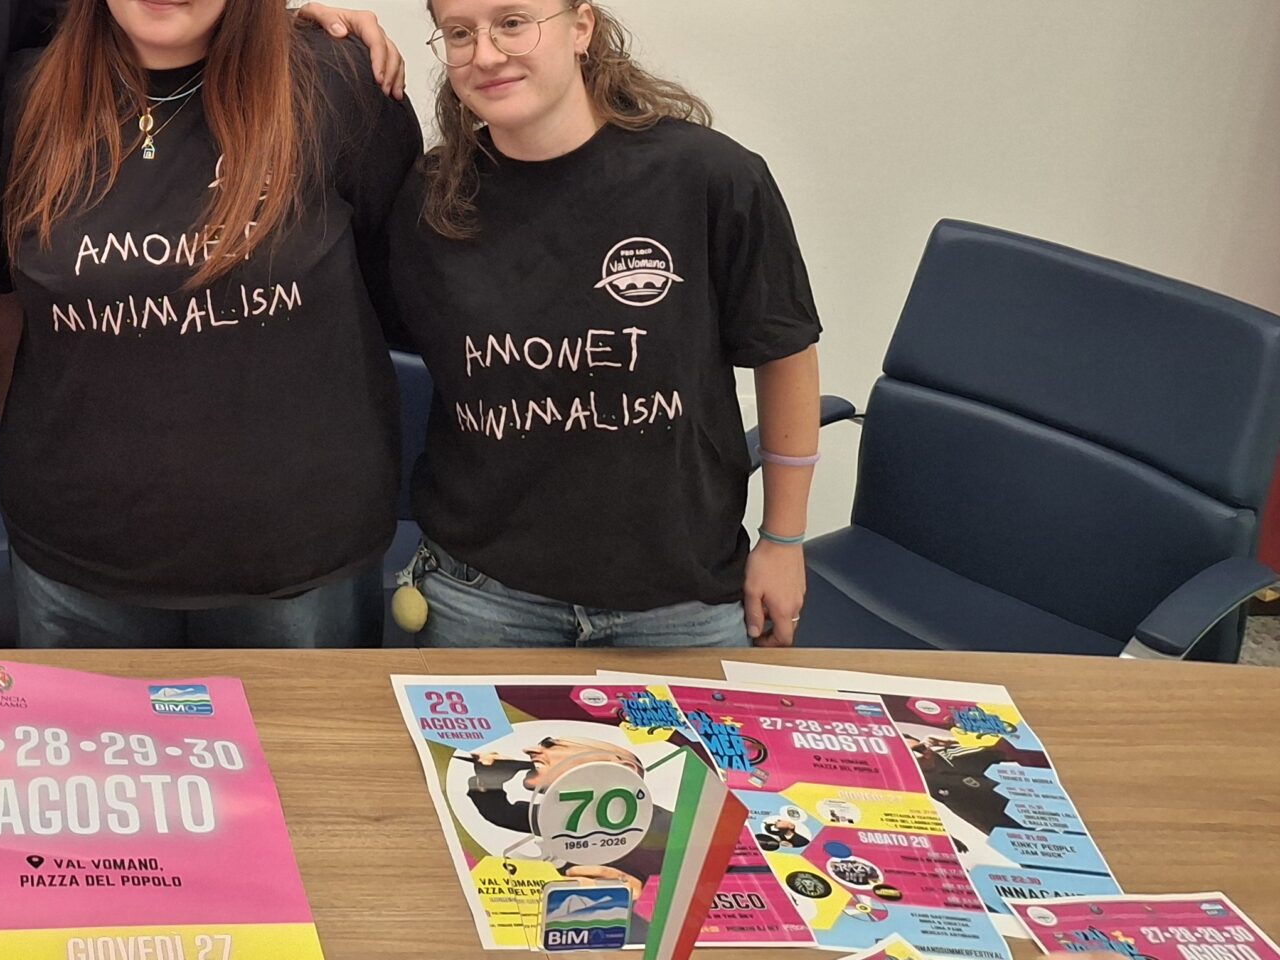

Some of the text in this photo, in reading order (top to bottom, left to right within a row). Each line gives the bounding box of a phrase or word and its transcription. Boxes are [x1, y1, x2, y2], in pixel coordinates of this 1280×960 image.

[610, 257, 666, 272] Val Vomano
[53, 281, 301, 335] MINIMALISM
[465, 327, 647, 377] AMONET
[456, 391, 683, 441] MINIMALISM
[425, 691, 468, 715] 28
[420, 717, 491, 730] AGOSTO
[793, 732, 889, 755] AGOSTO
[565, 837, 627, 850] 1956 2026
[858, 831, 908, 847] SABATO
[53, 858, 86, 871] VAL
[20, 873, 183, 888] PIAZZA DEL POPOLO
[479, 878, 501, 886] VAL
[547, 930, 589, 945] BiM
[195, 934, 232, 960] 27
